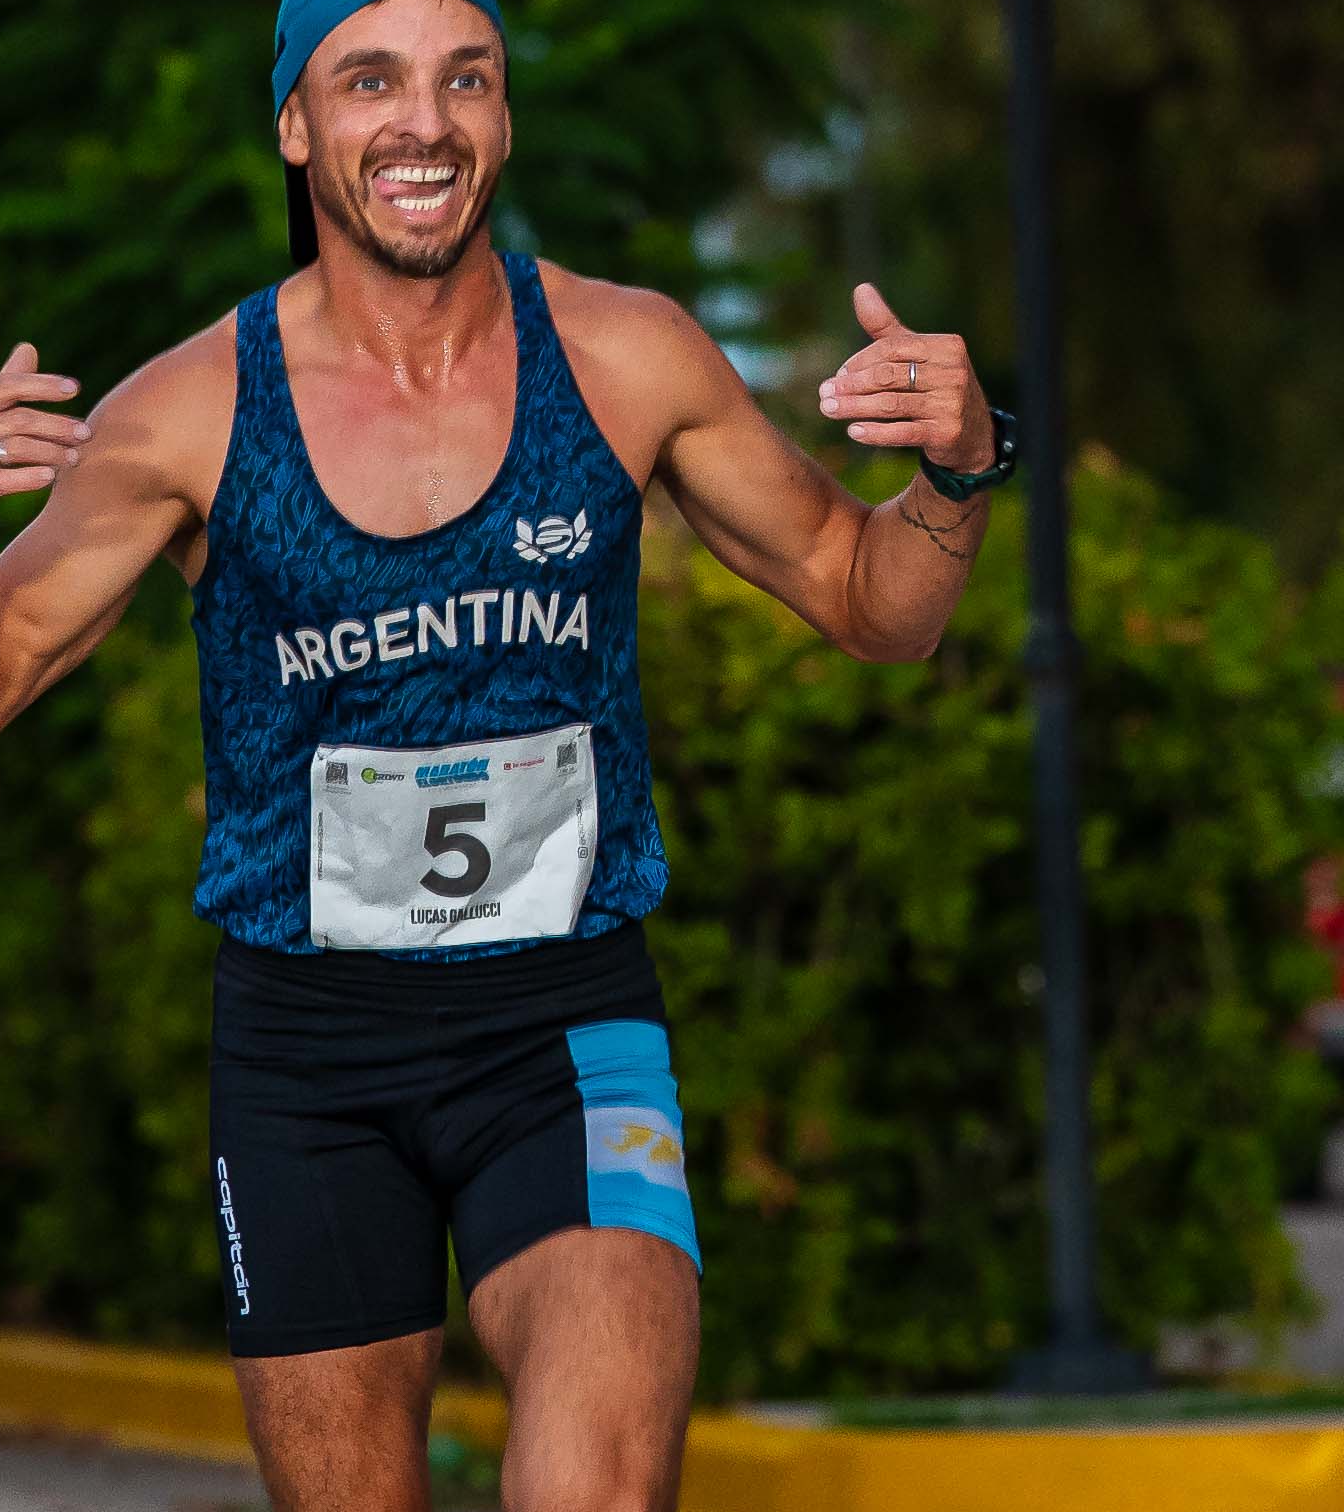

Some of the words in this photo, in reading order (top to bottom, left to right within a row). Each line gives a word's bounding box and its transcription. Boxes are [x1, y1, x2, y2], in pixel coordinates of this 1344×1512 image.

[275, 587, 589, 686] ARGENTINA
[419, 802, 492, 898] 5
[410, 908, 448, 925] LUCAS
[217, 1156, 250, 1316] capitán
